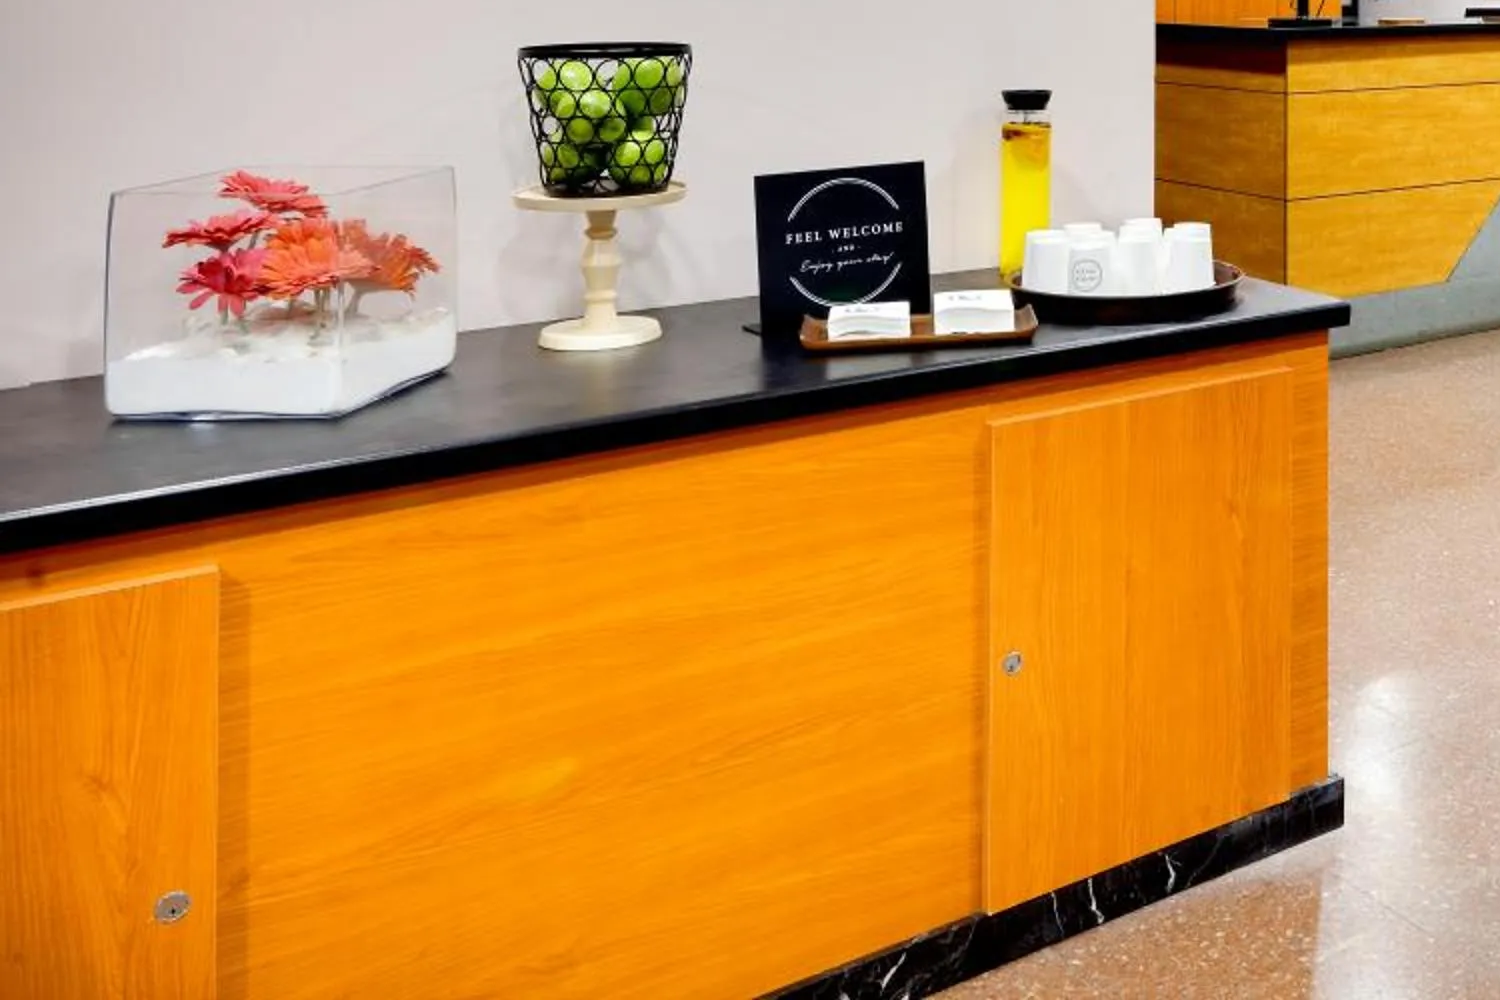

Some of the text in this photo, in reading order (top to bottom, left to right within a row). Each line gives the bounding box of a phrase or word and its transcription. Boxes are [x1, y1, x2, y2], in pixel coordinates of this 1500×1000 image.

[785, 221, 903, 245] FEEL WELCOME
[799, 259, 834, 275] Enjoy
[836, 258, 863, 271] your
